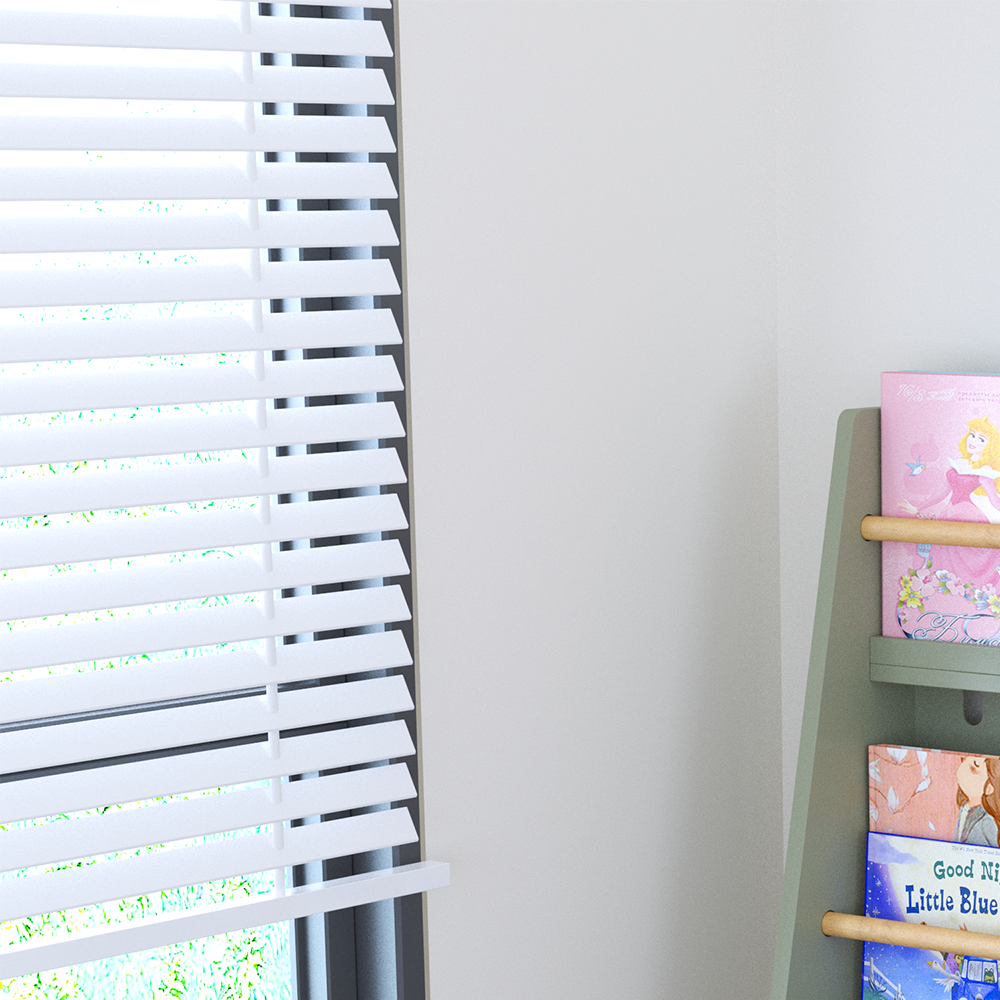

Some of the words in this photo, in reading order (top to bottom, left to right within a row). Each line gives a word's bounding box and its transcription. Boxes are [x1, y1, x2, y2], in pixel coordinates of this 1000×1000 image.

[933, 859, 975, 880] Good
[905, 884, 954, 914] Little
[959, 886, 998, 915] Blue
